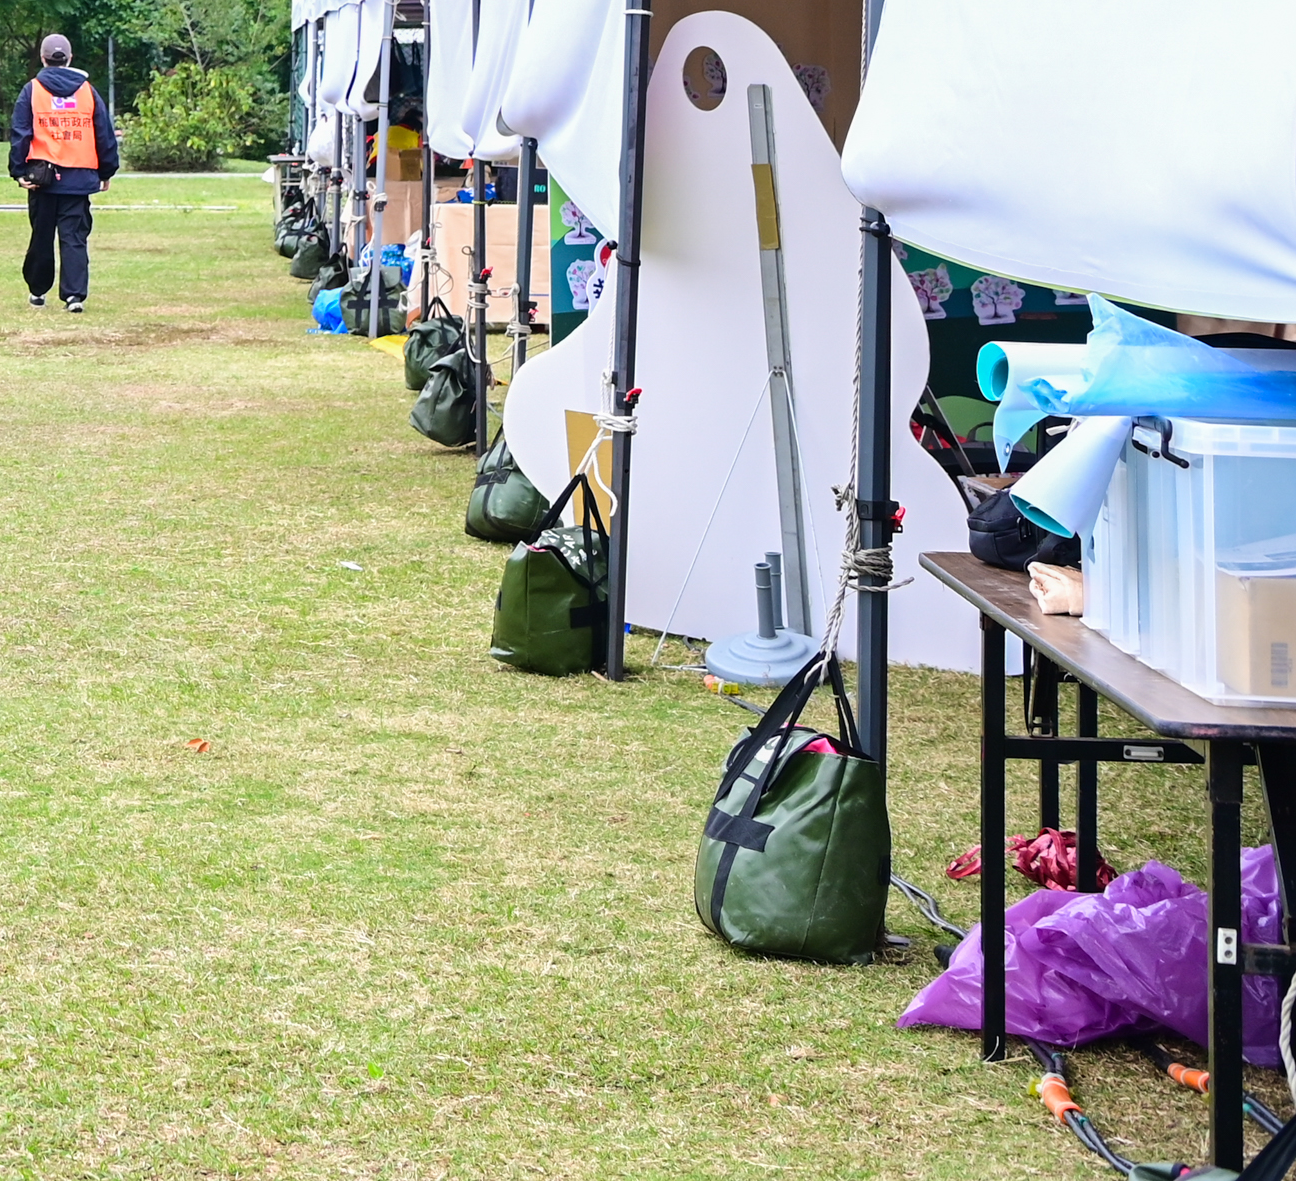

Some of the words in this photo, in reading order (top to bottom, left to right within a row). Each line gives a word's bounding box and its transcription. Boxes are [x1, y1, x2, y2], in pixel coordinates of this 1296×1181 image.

[38, 116, 91, 129] 桃園市政府
[50, 129, 83, 142] 社會局
